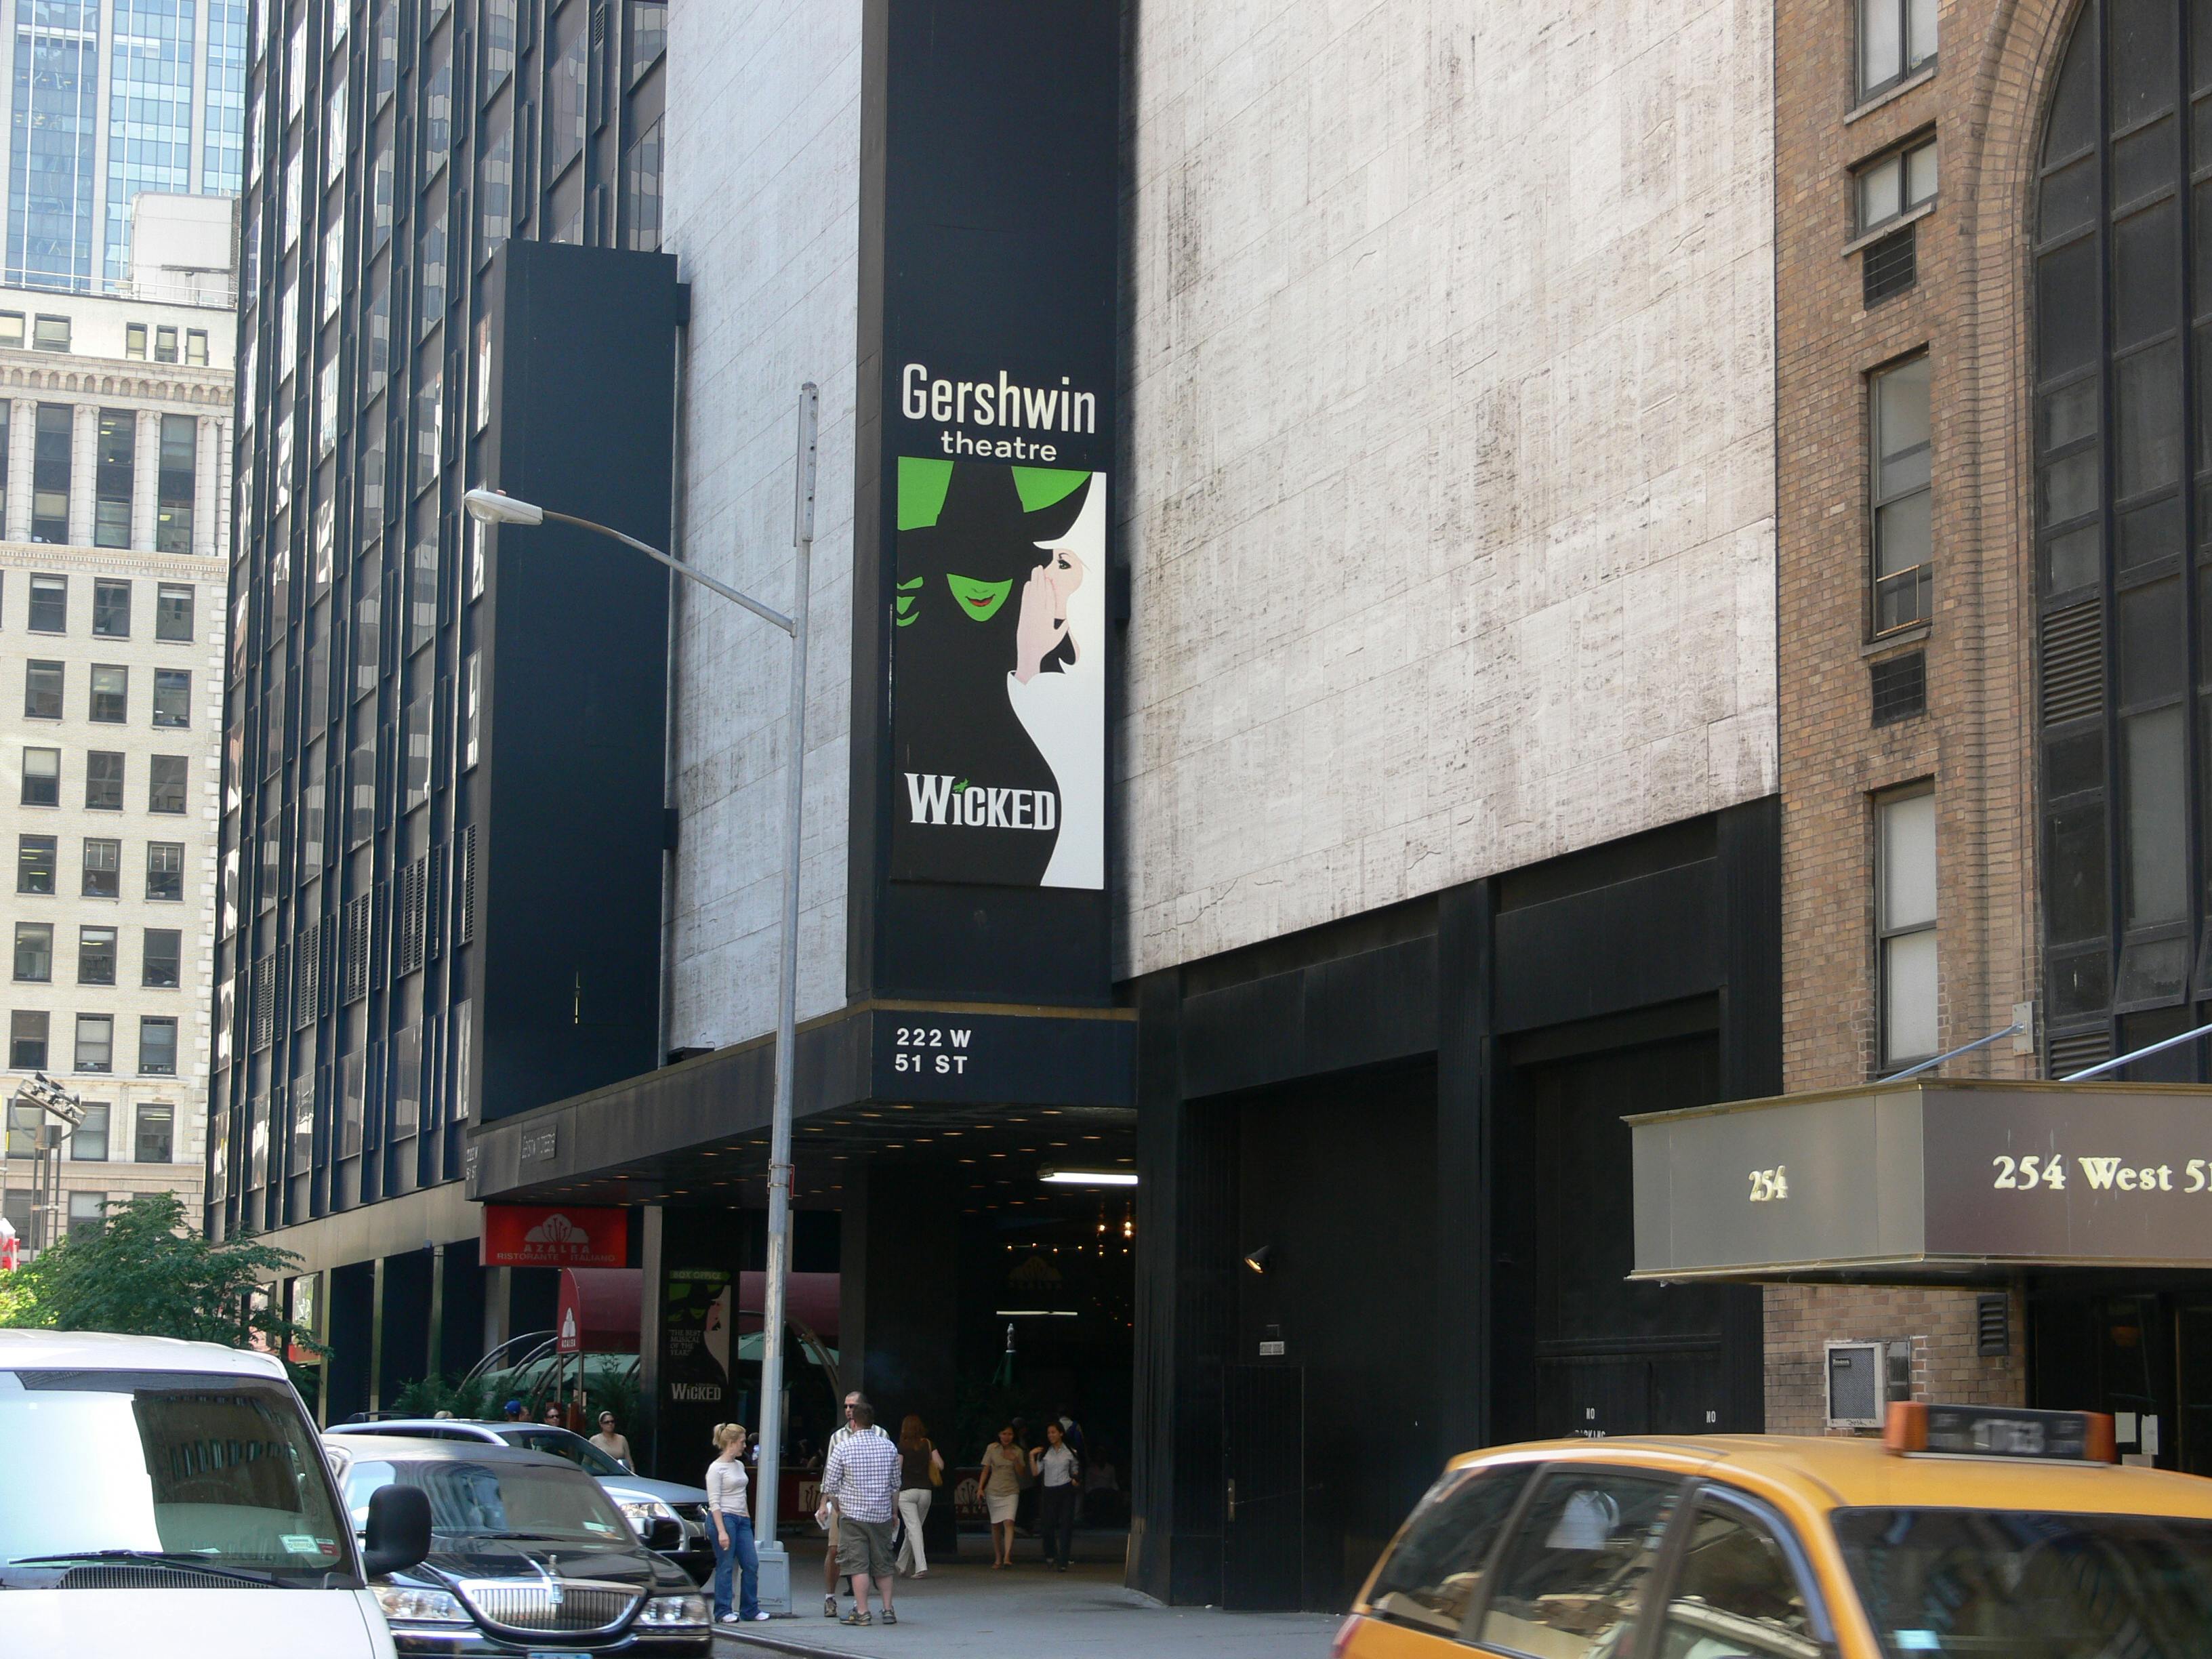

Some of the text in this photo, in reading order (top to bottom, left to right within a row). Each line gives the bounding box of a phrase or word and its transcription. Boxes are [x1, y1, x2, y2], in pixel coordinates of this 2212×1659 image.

[902, 363, 1096, 434] Gershwin
[941, 430, 1057, 462] theatre
[897, 1027, 972, 1048] 222 W
[895, 1053, 968, 1074] 51 ST
[1993, 1153, 2066, 1191] 254
[2078, 1157, 2173, 1191] West
[1748, 1165, 1788, 1202] 254
[497, 1252, 559, 1261] RISTORANTE
[524, 1244, 590, 1253] AZALEA
[673, 1270, 691, 1279] BOX
[1586, 1408, 1595, 1420] NO
[1706, 1410, 1716, 1422] NO
